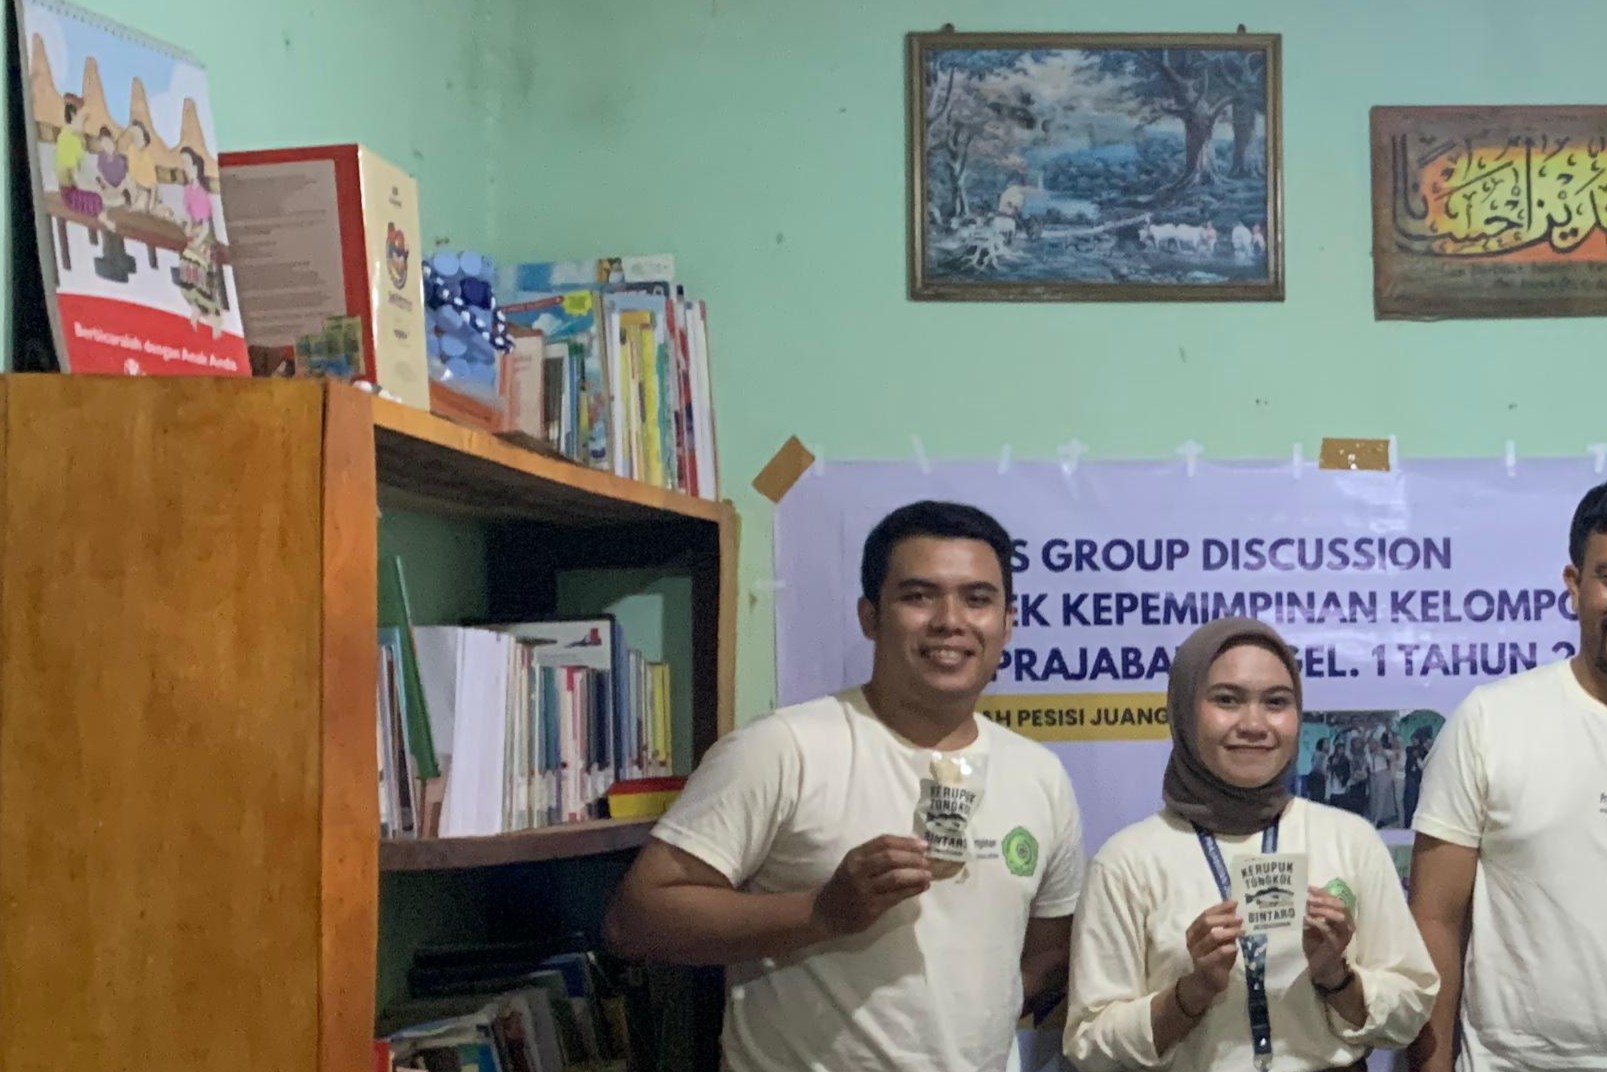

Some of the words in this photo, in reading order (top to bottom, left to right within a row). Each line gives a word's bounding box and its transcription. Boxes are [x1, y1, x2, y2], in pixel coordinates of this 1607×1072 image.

[1041, 538, 1190, 573] GROUP
[1202, 536, 1452, 572] DISCUSSION
[1062, 590, 1378, 626] KEPEMIMPINAN
[1390, 588, 1580, 623] KELOMPO
[991, 645, 1174, 682] PRAJABA
[1372, 644, 1386, 677] 1
[1399, 641, 1538, 677] TAHUN
[1017, 707, 1085, 727] PESISI
[1090, 706, 1169, 727] JUANG
[1240, 861, 1294, 879] KERUPUK
[1245, 875, 1292, 889] TONGKOL
[1248, 907, 1296, 923] BINTARO
